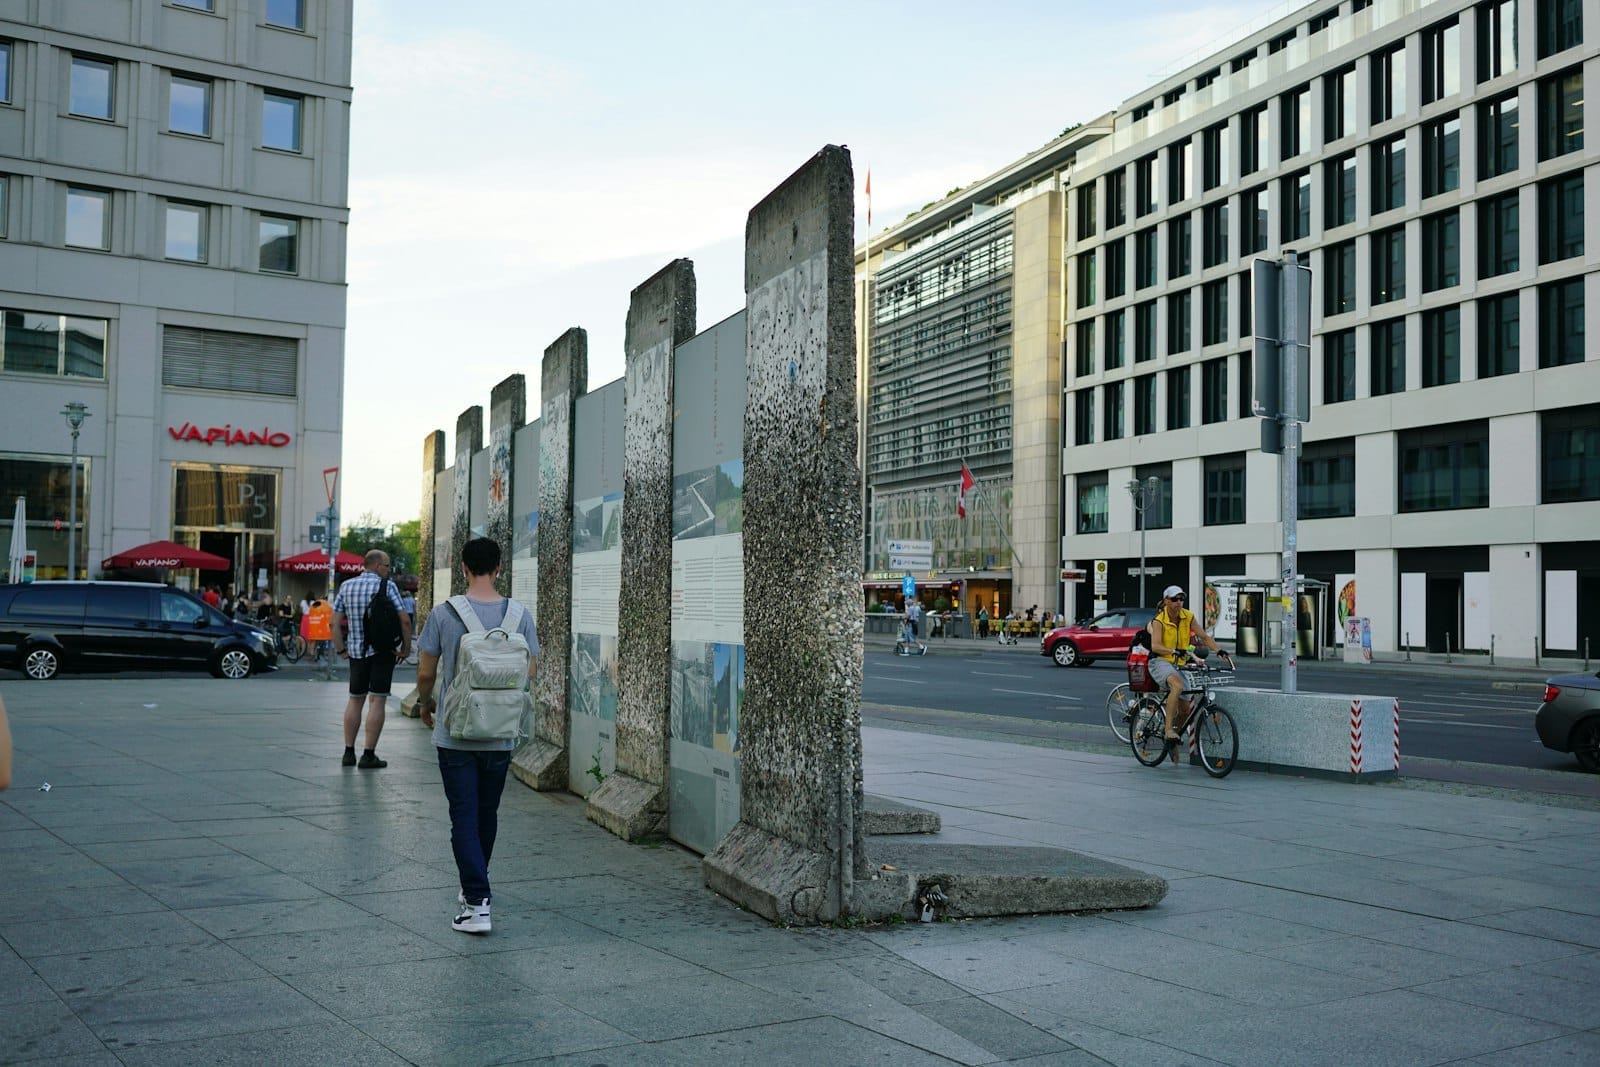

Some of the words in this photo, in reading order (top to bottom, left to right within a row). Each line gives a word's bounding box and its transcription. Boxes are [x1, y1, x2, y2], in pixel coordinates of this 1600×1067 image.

[168, 421, 291, 448] VAPIANO
[135, 558, 180, 568] VAPIANO
[340, 563, 366, 571] VAPIA
